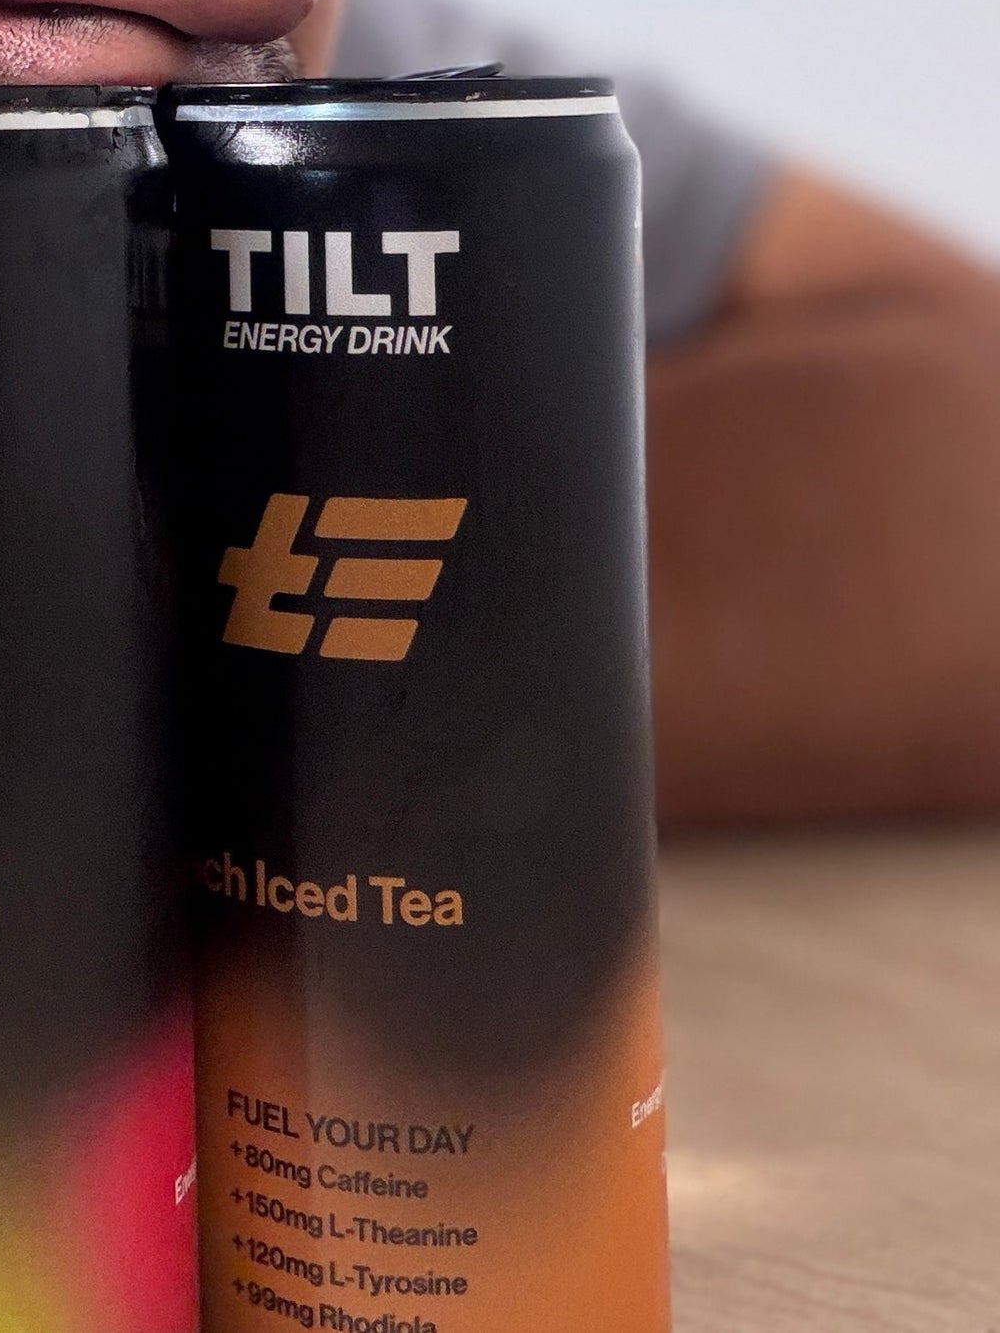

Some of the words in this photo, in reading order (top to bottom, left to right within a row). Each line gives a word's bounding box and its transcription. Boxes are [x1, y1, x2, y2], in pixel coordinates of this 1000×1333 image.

[210, 228, 460, 316] TILT
[223, 320, 343, 354] ENERGY
[347, 325, 453, 355] DRINK
[255, 859, 358, 922] Iced
[368, 875, 464, 927] Tea
[227, 1088, 299, 1140] FUEL
[304, 1112, 401, 1154] YOUR
[408, 1124, 476, 1155] DAY
[230, 1139, 312, 1189] +80mg
[317, 1164, 430, 1199] Caffeine
[230, 1187, 324, 1239] +150mg
[329, 1212, 479, 1247] L-Theanine
[232, 1233, 324, 1287] +120mg
[329, 1261, 469, 1297] L-Tyrosine
[232, 1277, 315, 1329] +99mg
